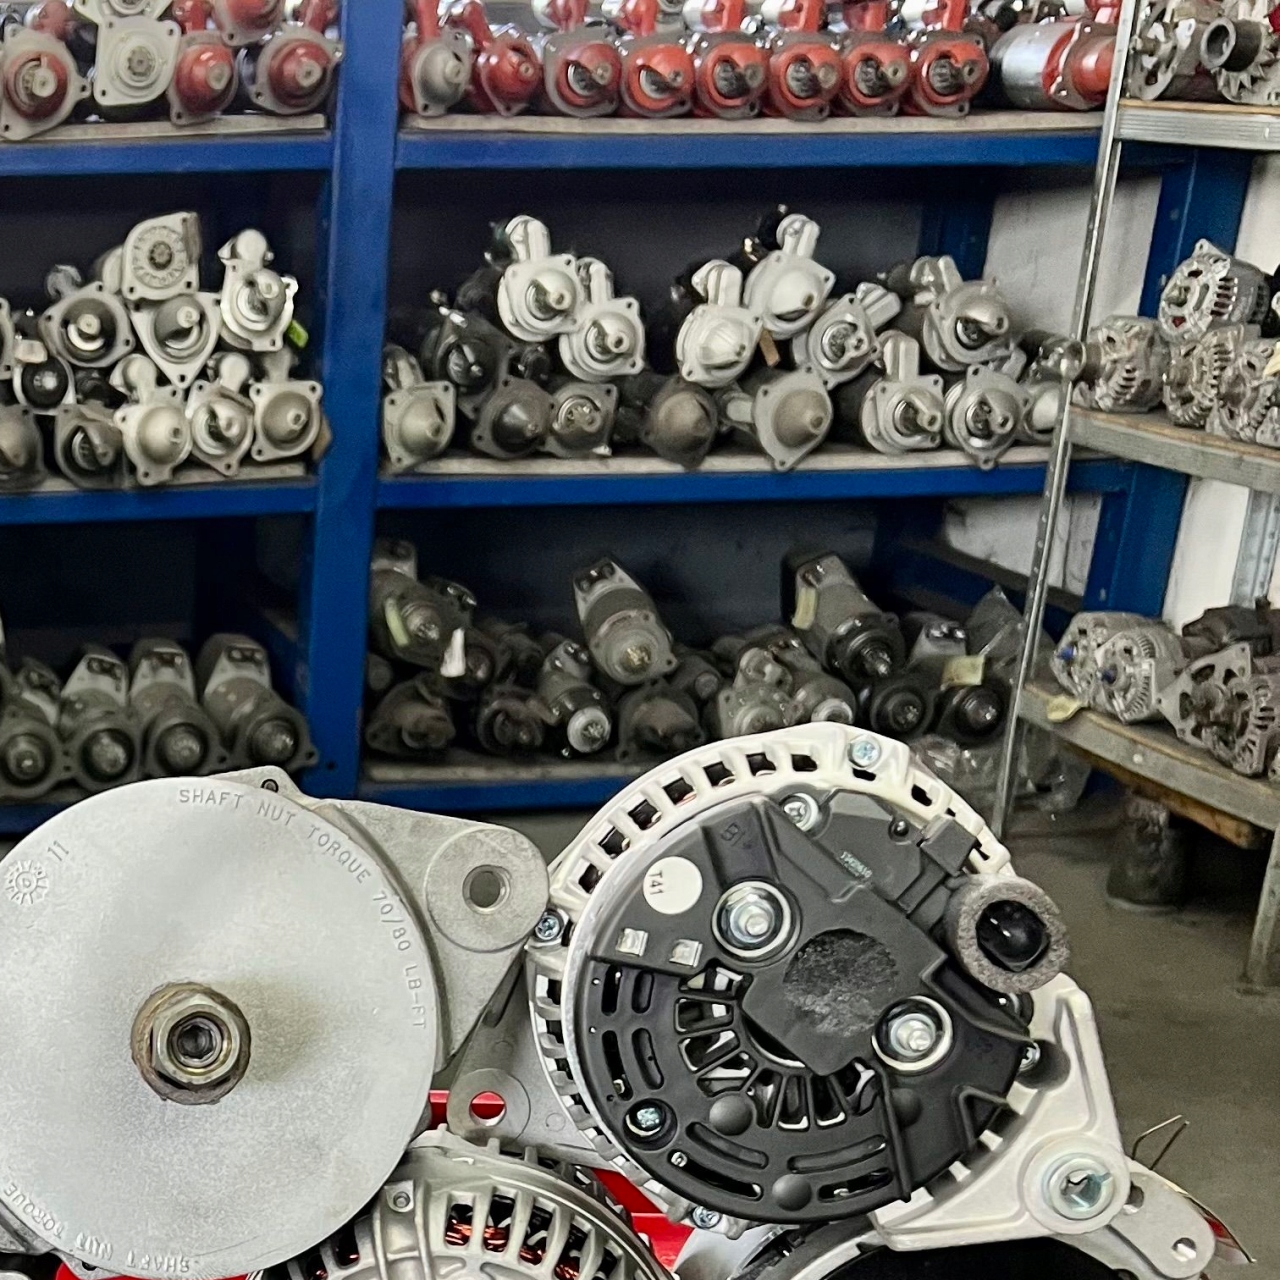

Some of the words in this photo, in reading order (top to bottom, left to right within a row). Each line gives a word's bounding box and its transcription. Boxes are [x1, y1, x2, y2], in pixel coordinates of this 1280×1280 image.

[179, 789, 244, 809] SHAFT
[257, 800, 296, 826] NUT
[307, 824, 372, 884] TORQUE
[372, 890, 412, 952] 70/80
[405, 965, 427, 1029] LB-FT
[649, 870, 664, 895] T41
[4, 1183, 69, 1241] TORQUE
